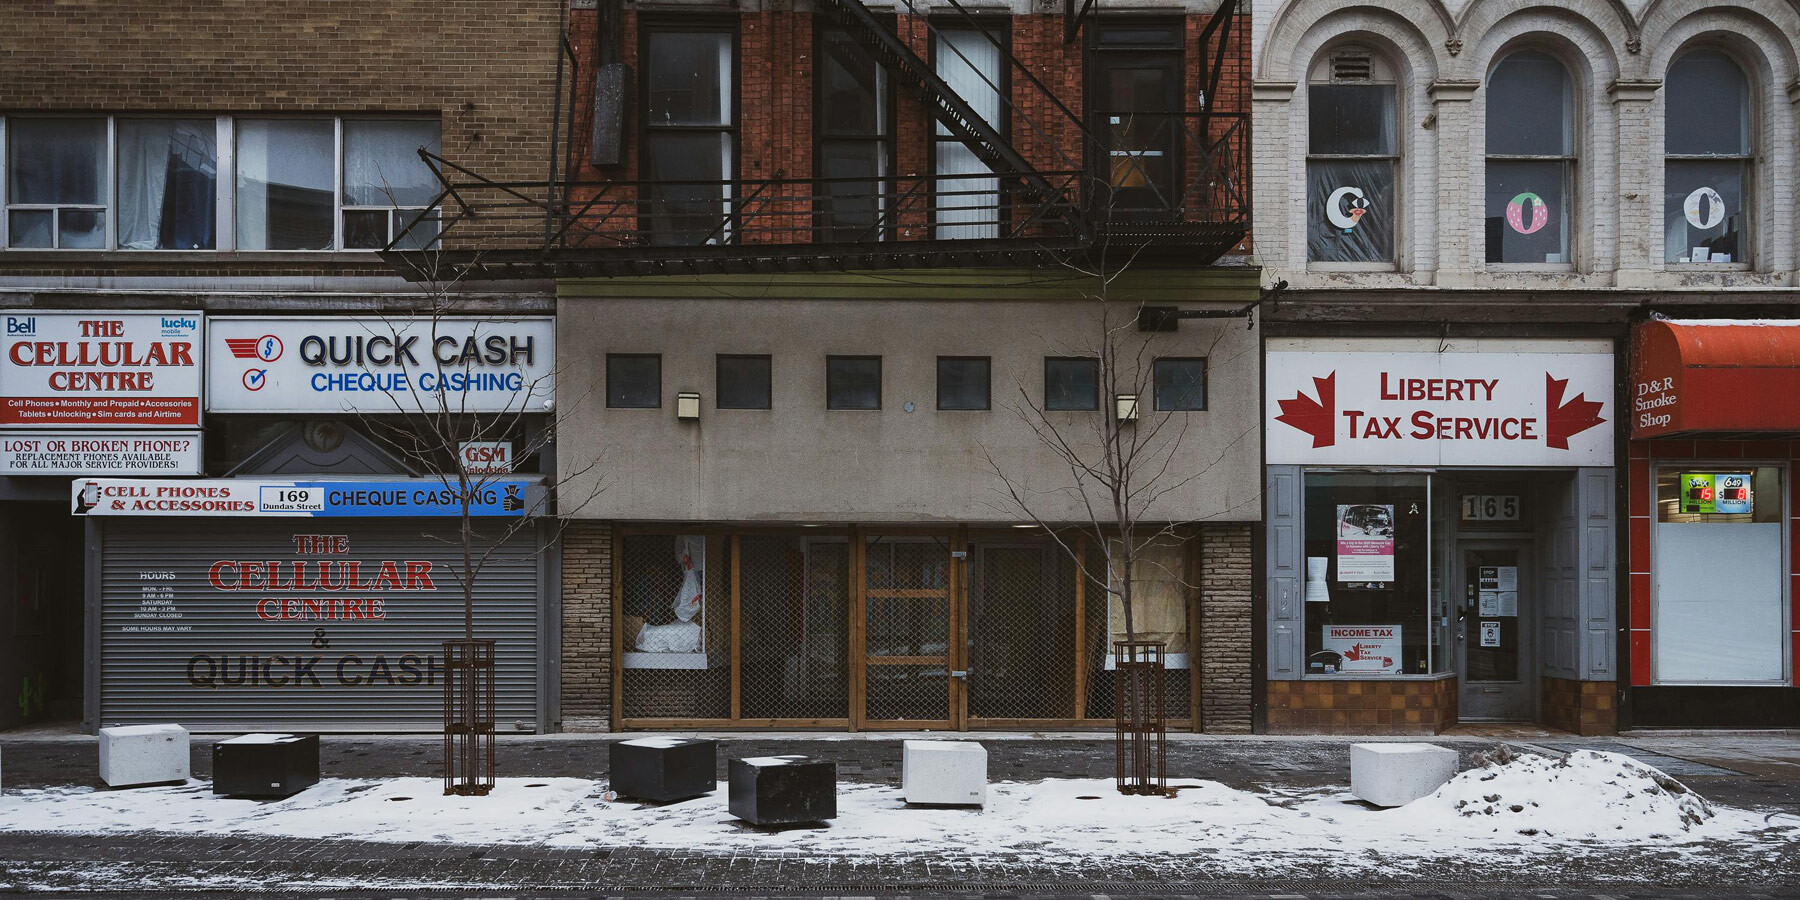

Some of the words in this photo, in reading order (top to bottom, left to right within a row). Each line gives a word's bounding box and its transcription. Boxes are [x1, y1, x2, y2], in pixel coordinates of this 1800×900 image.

[1326, 186, 1366, 229] C
[1506, 192, 1548, 234] O
[1684, 186, 1725, 230] O
[7, 317, 36, 333] Bell
[78, 320, 125, 337] THE
[161, 317, 196, 330] lucky
[9, 341, 195, 367] CELLULAR
[300, 335, 419, 366] QUICK
[433, 335, 534, 366] CASH
[48, 371, 155, 391] CENTRE
[311, 372, 407, 392] CHEQUE
[419, 372, 522, 392] CASHING
[1380, 372, 1499, 401] LIBERTY
[60, 400, 91, 409] Monthly
[110, 400, 140, 408] Prepaid
[1635, 392, 1677, 411] Smoke
[52, 411, 91, 419] Unlocking
[1640, 412, 1671, 428] Shop
[1343, 410, 1403, 439] TAX
[1410, 410, 1538, 440] SERVICE
[5, 440, 41, 452] LOST
[47, 440, 66, 452] OR
[72, 440, 129, 452] BROKEN
[134, 440, 190, 452] PHONE?
[16, 453, 80, 461] REPLACEMENT
[84, 453, 119, 461] PHONES
[122, 453, 171, 461] AVAILABLE
[465, 447, 505, 462] GSM
[104, 487, 150, 498] CELL
[157, 487, 231, 498] PHONES
[279, 490, 309, 502] 169
[329, 490, 407, 506] CHEQUE
[1701, 488, 1712, 500] 15
[1719, 491, 1724, 499] $
[1737, 488, 1745, 500] 8
[111, 500, 126, 511] &
[132, 500, 255, 512] ACCESSORIES
[1467, 497, 1516, 518] 165
[292, 534, 350, 555] THE
[140, 571, 176, 580] HOURS
[208, 560, 437, 591] CELLULAR
[255, 597, 386, 621] CENTRE
[311, 627, 330, 649] &
[1331, 629, 1371, 637] INCOME
[1372, 629, 1393, 637] TAX
[186, 653, 325, 691] QUICK
[336, 654, 446, 689] CASH
